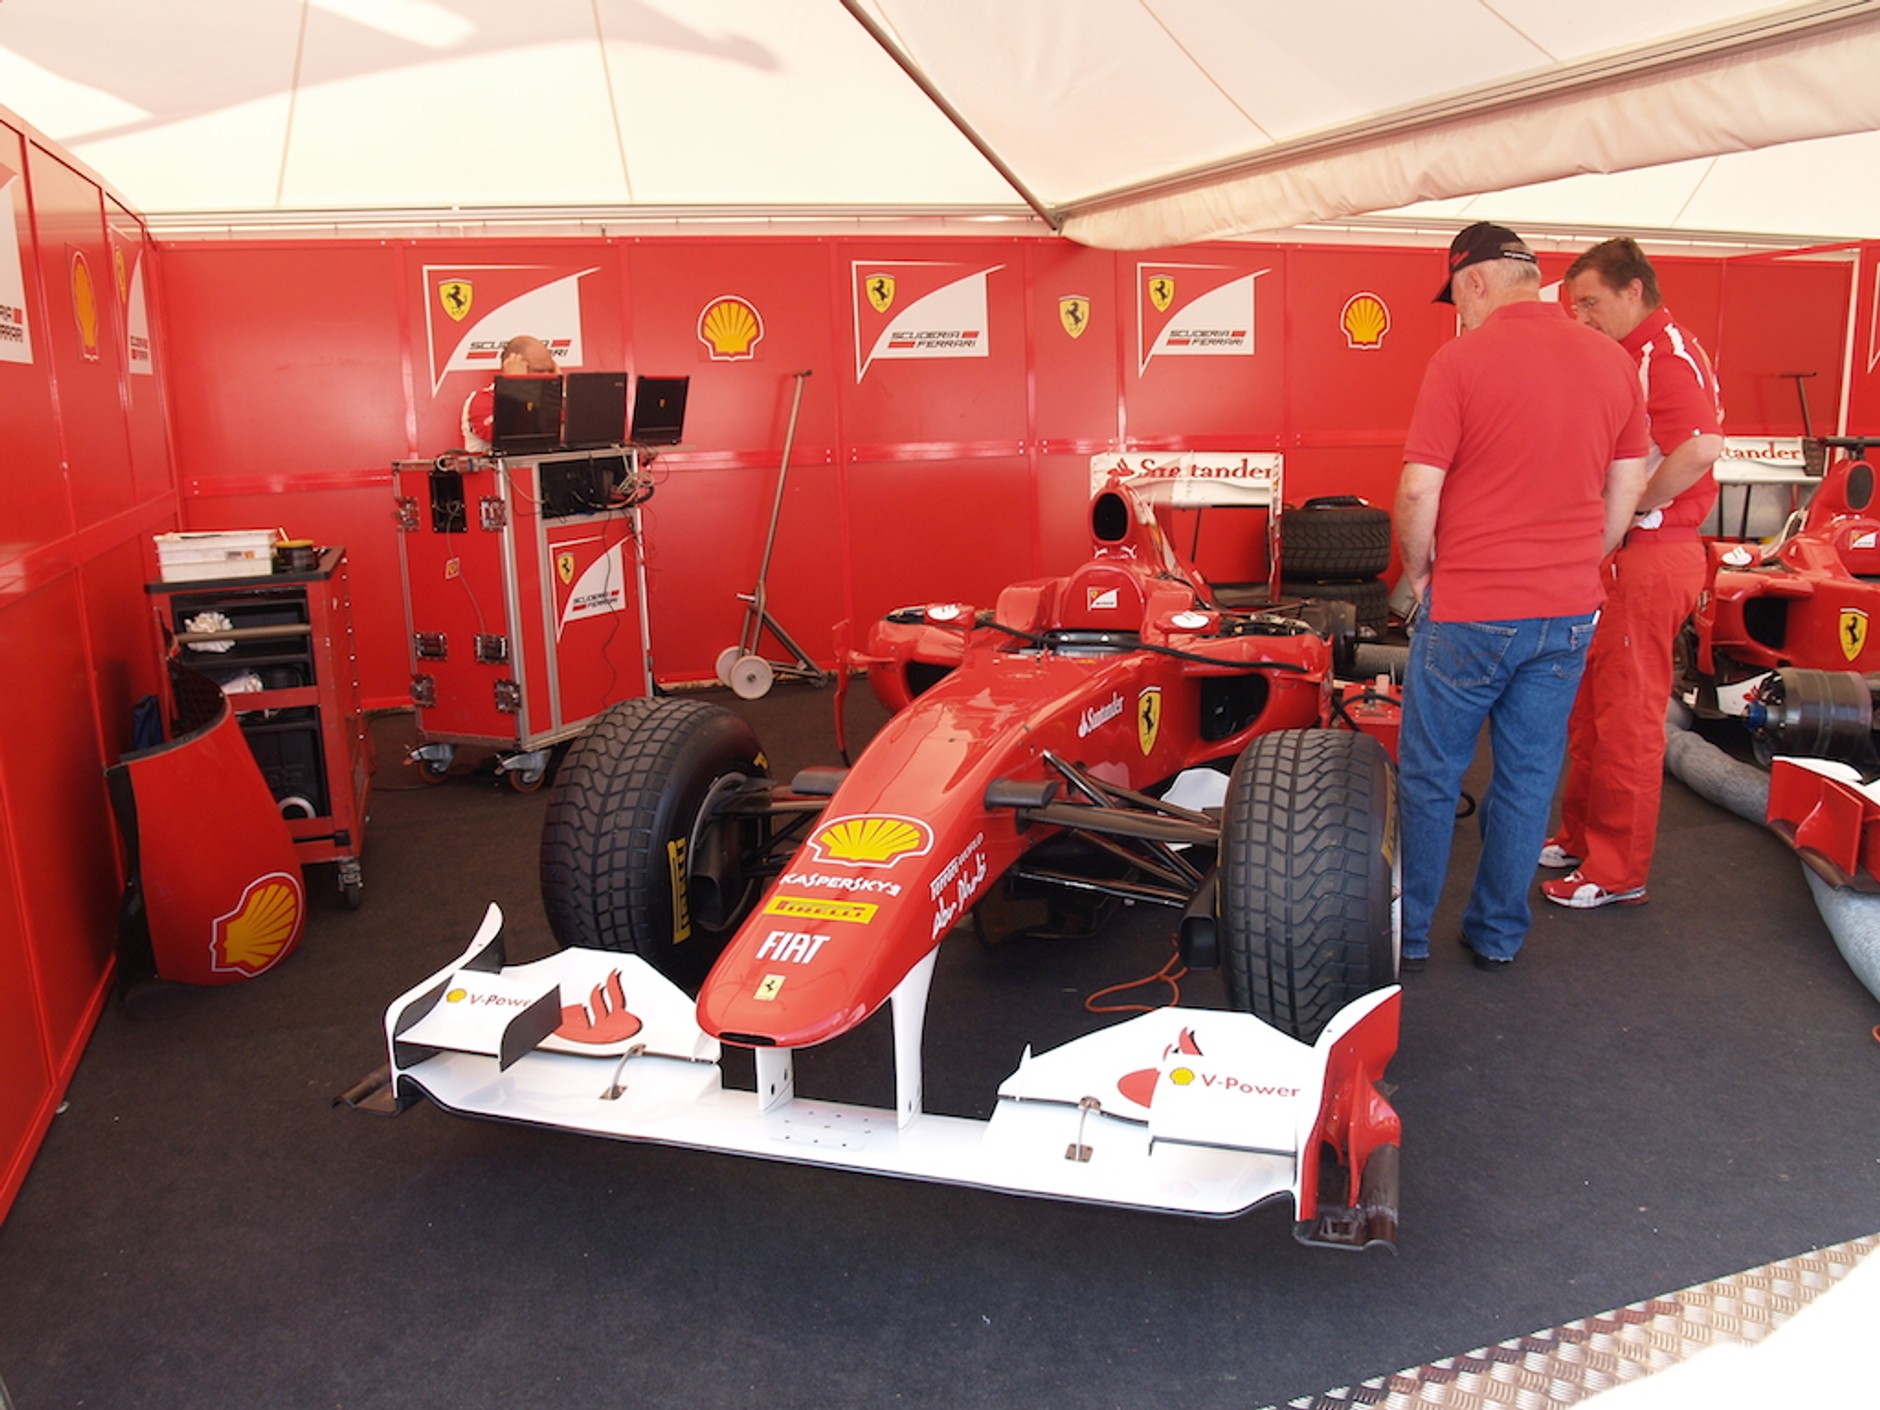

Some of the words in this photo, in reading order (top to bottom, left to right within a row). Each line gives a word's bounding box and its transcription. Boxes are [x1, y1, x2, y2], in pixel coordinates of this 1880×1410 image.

[892, 331, 961, 339] SCUDERIA
[916, 339, 977, 348] FERRARI
[779, 873, 891, 892] KASPERSKY
[774, 900, 867, 918] PIRELLI
[755, 930, 831, 964] FIAT
[1201, 1073, 1301, 1097] V-Power
